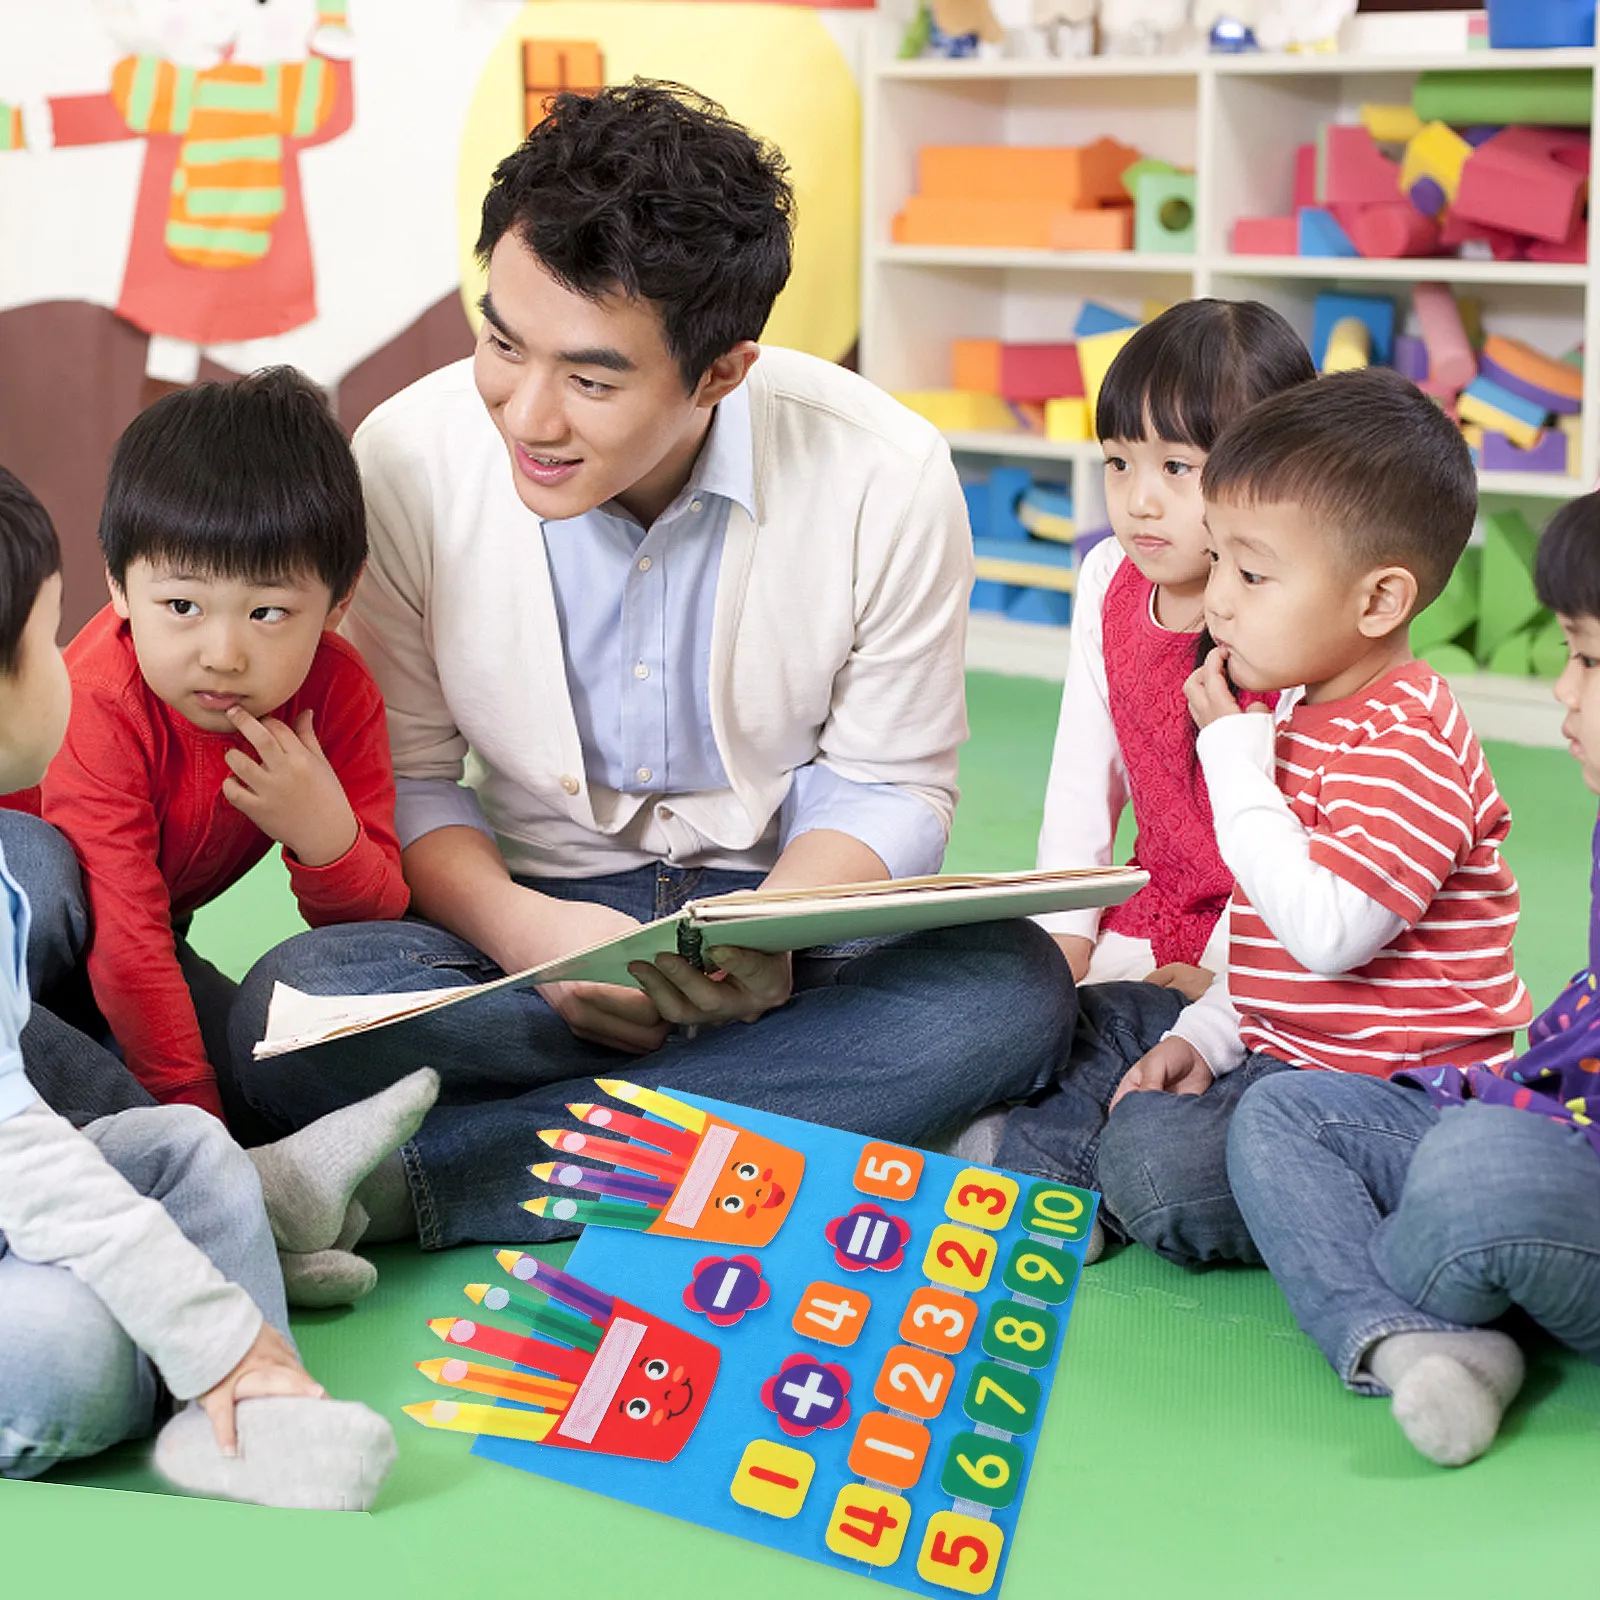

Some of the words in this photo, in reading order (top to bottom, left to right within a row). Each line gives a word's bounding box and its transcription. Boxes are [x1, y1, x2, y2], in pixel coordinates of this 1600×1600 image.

[957, 1183, 1007, 1215] 3
[1031, 1190, 1084, 1233] 10
[936, 1240, 988, 1277] 2
[1015, 1254, 1064, 1285] 9
[748, 1466, 799, 1490] 1
[805, 1299, 857, 1331] 4
[864, 1156, 911, 1186] 5
[913, 1304, 964, 1337] 3
[994, 1318, 1046, 1351] 8
[889, 1363, 943, 1402] 2
[974, 1376, 1026, 1414] 7
[865, 1438, 915, 1459] 1
[956, 1453, 1010, 1488] 6
[839, 1505, 898, 1547] 4
[930, 1530, 989, 1574] 5
